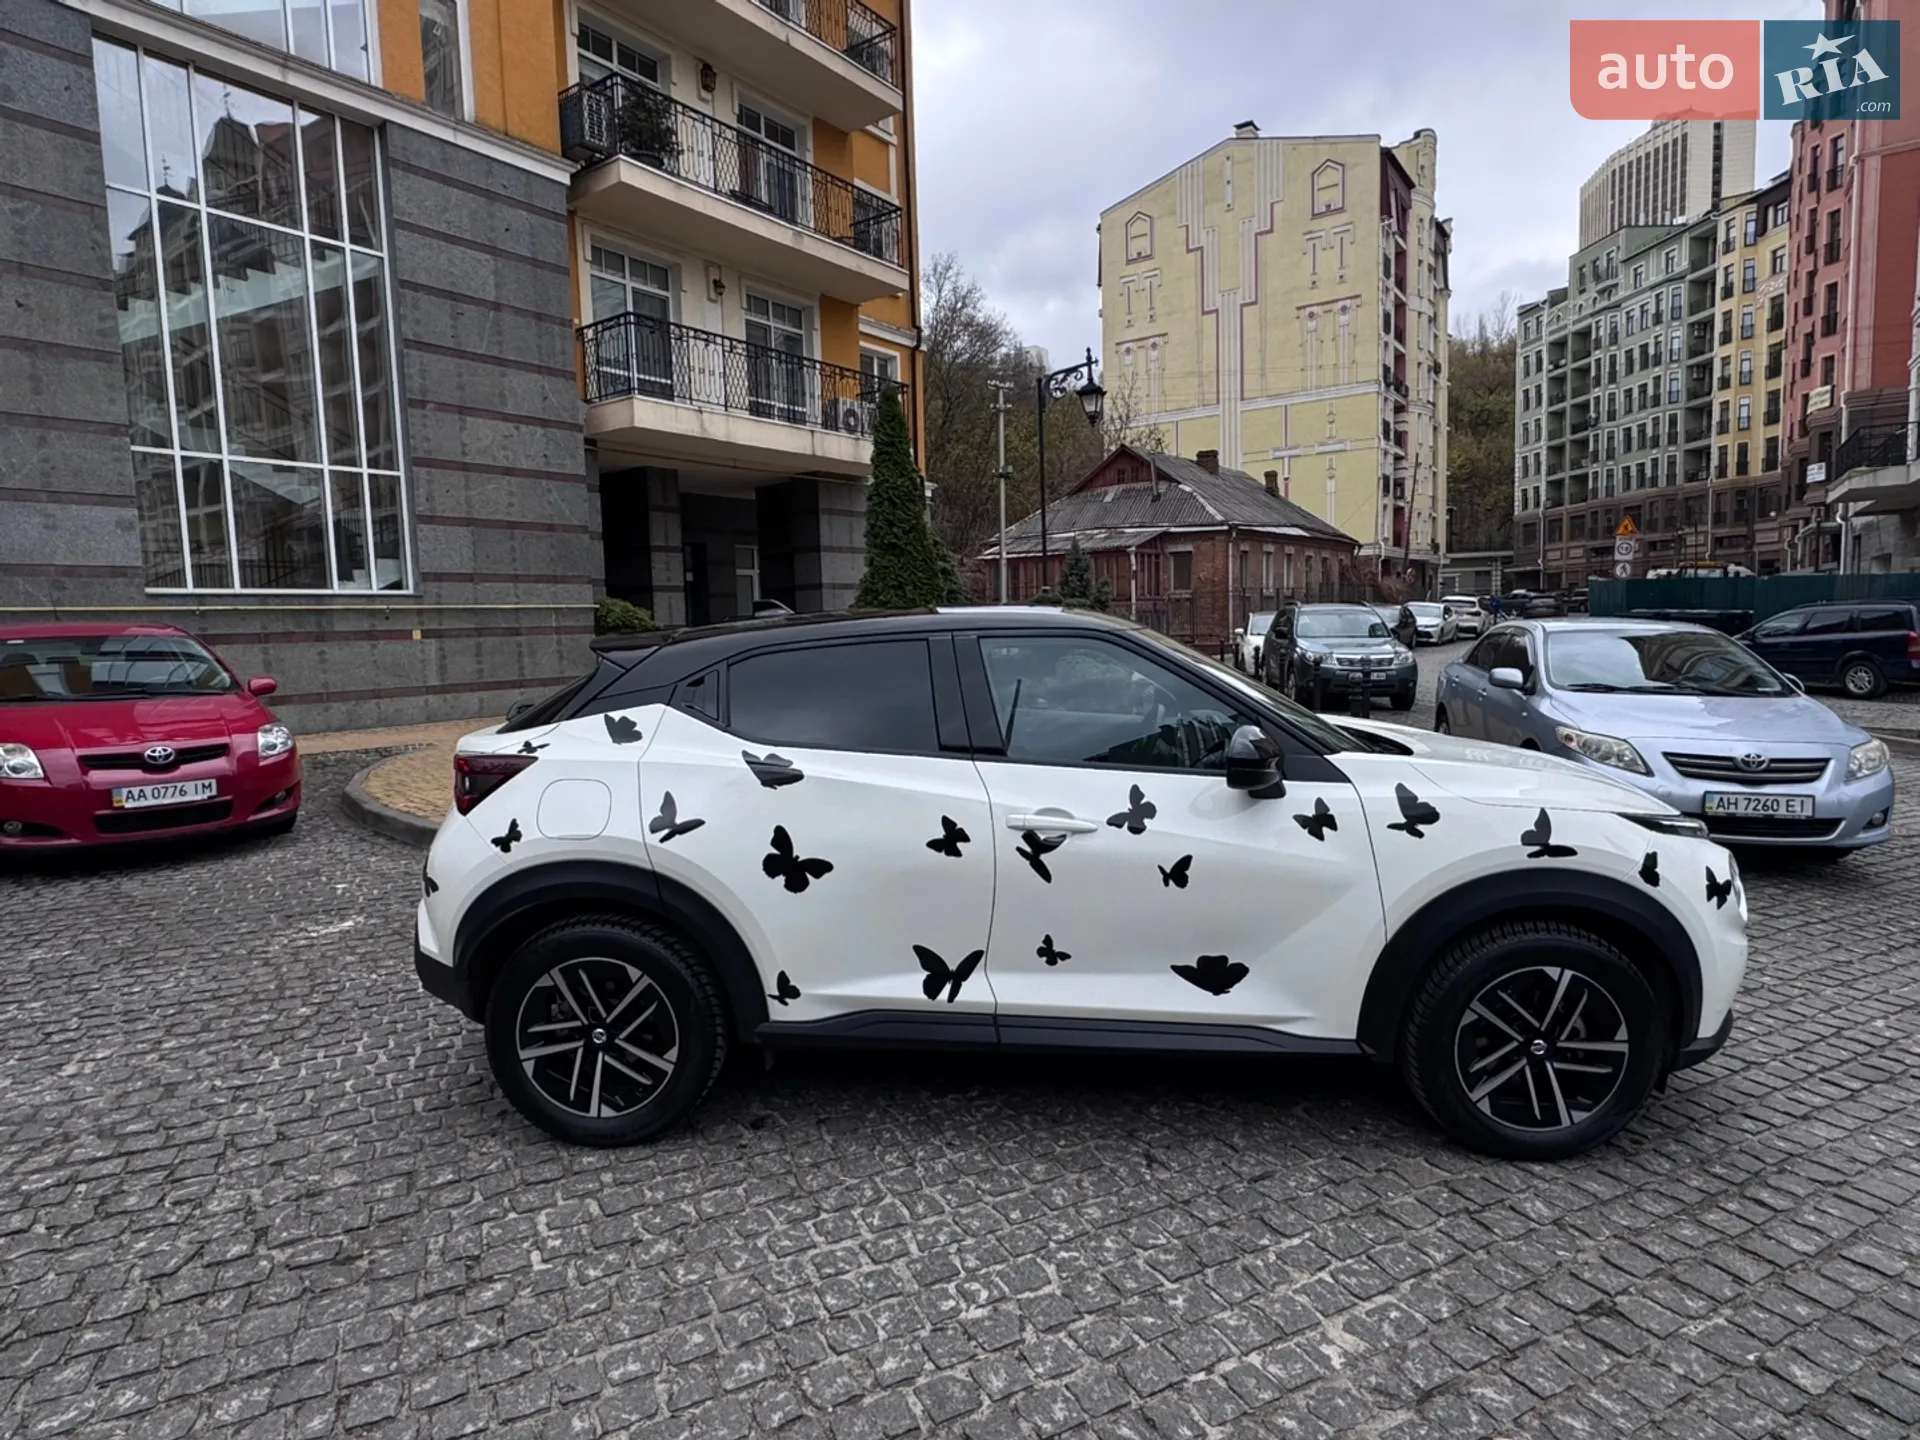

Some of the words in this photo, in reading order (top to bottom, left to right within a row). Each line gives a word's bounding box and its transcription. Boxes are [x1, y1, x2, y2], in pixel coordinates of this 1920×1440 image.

[125, 789, 148, 803] AA
[151, 785, 187, 800] 0776
[195, 782, 212, 795] IM
[1716, 797, 1738, 810] AH
[1743, 798, 1780, 812] 7260
[1786, 799, 1805, 813] EI
